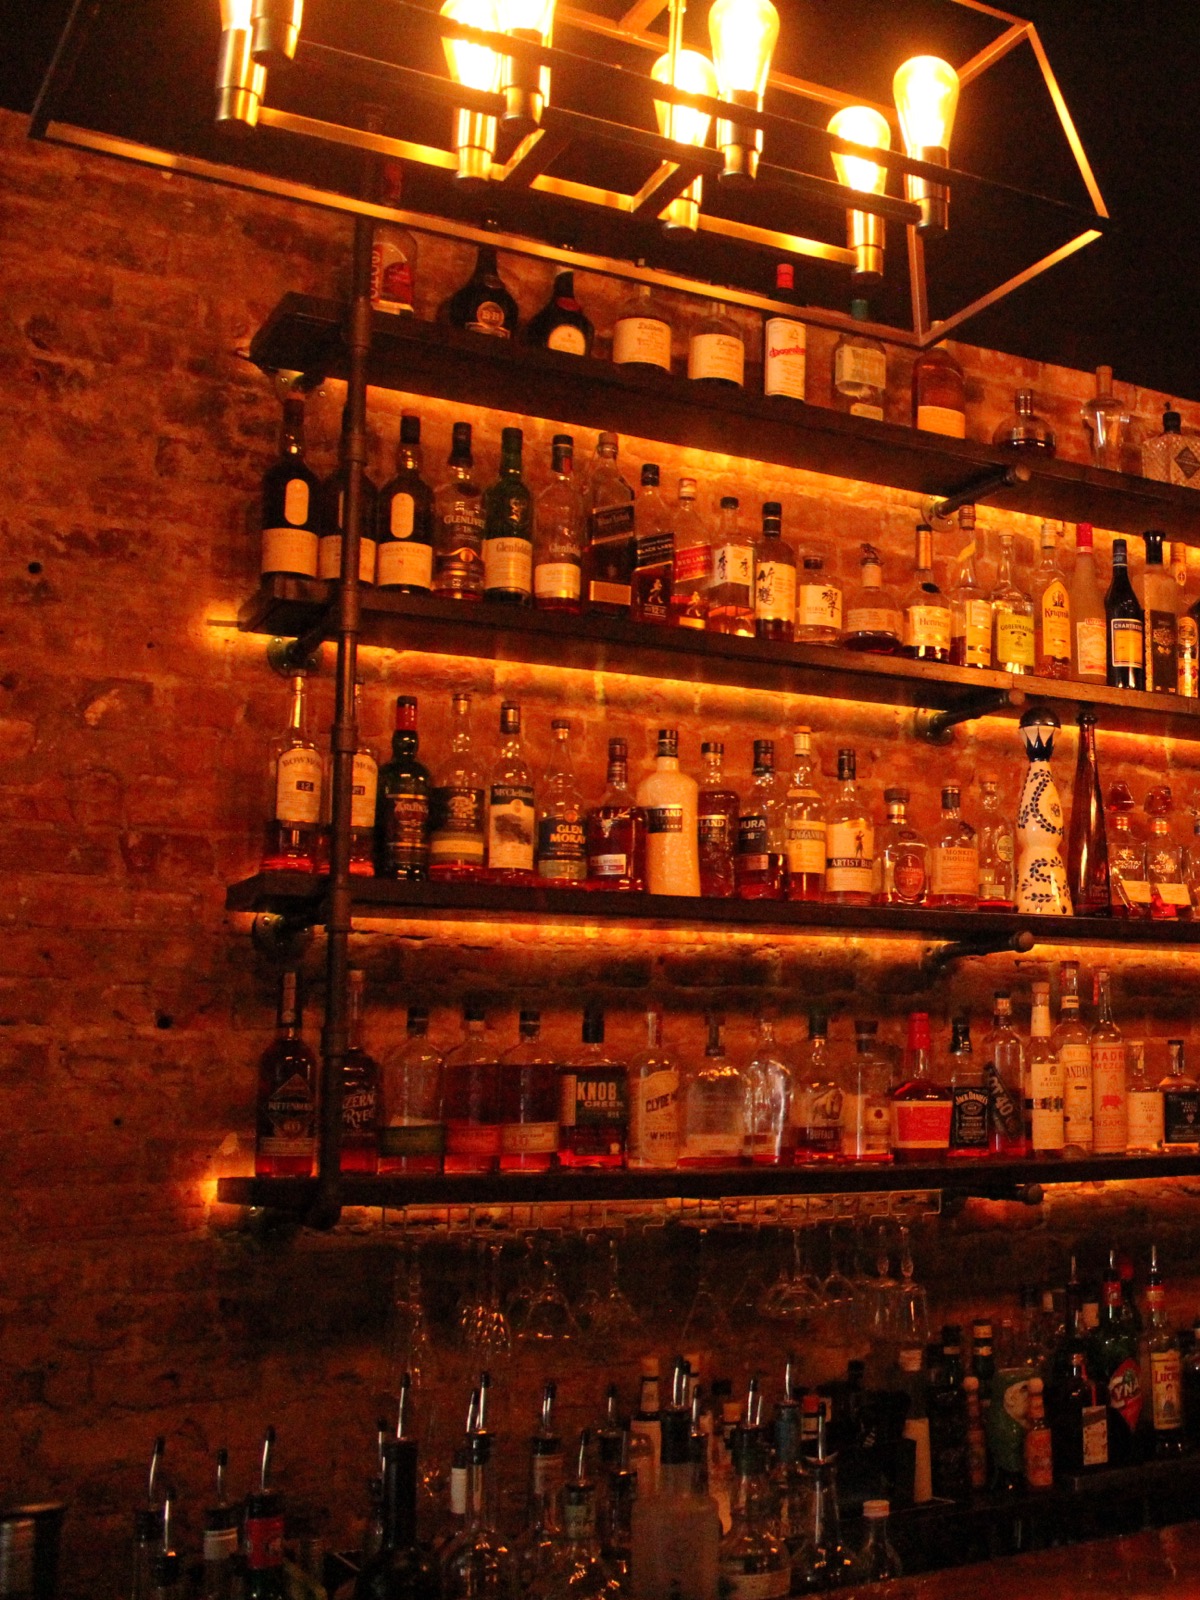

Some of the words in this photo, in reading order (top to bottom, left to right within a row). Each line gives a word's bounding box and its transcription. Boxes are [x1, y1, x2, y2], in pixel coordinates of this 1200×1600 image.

[556, 824, 582, 834] GLEN
[831, 858, 859, 867] ARTIST
[577, 1081, 617, 1101] KNOB
[1109, 1375, 1141, 1410] CYNA
